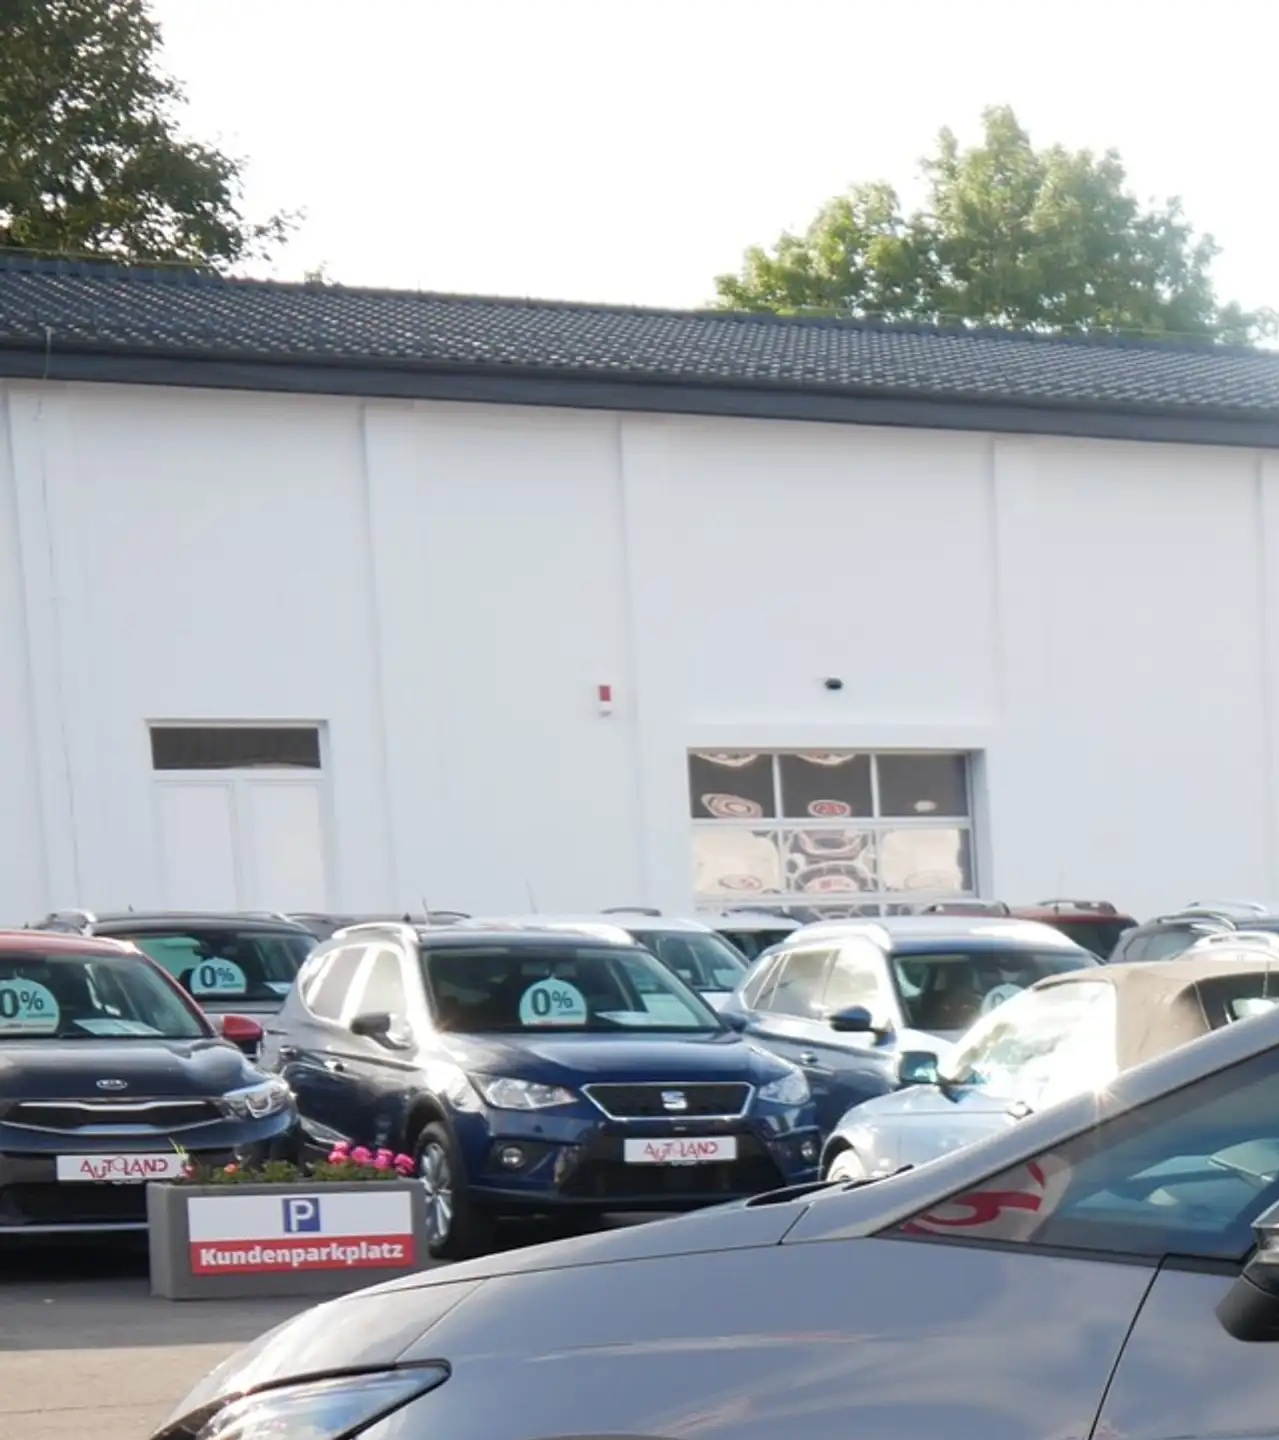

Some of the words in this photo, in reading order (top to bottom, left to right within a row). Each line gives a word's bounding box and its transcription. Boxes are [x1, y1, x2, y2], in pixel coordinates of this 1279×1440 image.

[200, 966, 235, 989] 0%
[0, 988, 45, 1018] 0%
[531, 988, 574, 1016] 0%
[289, 1200, 314, 1232] P
[201, 1242, 404, 1268] Kundenparkplatz
